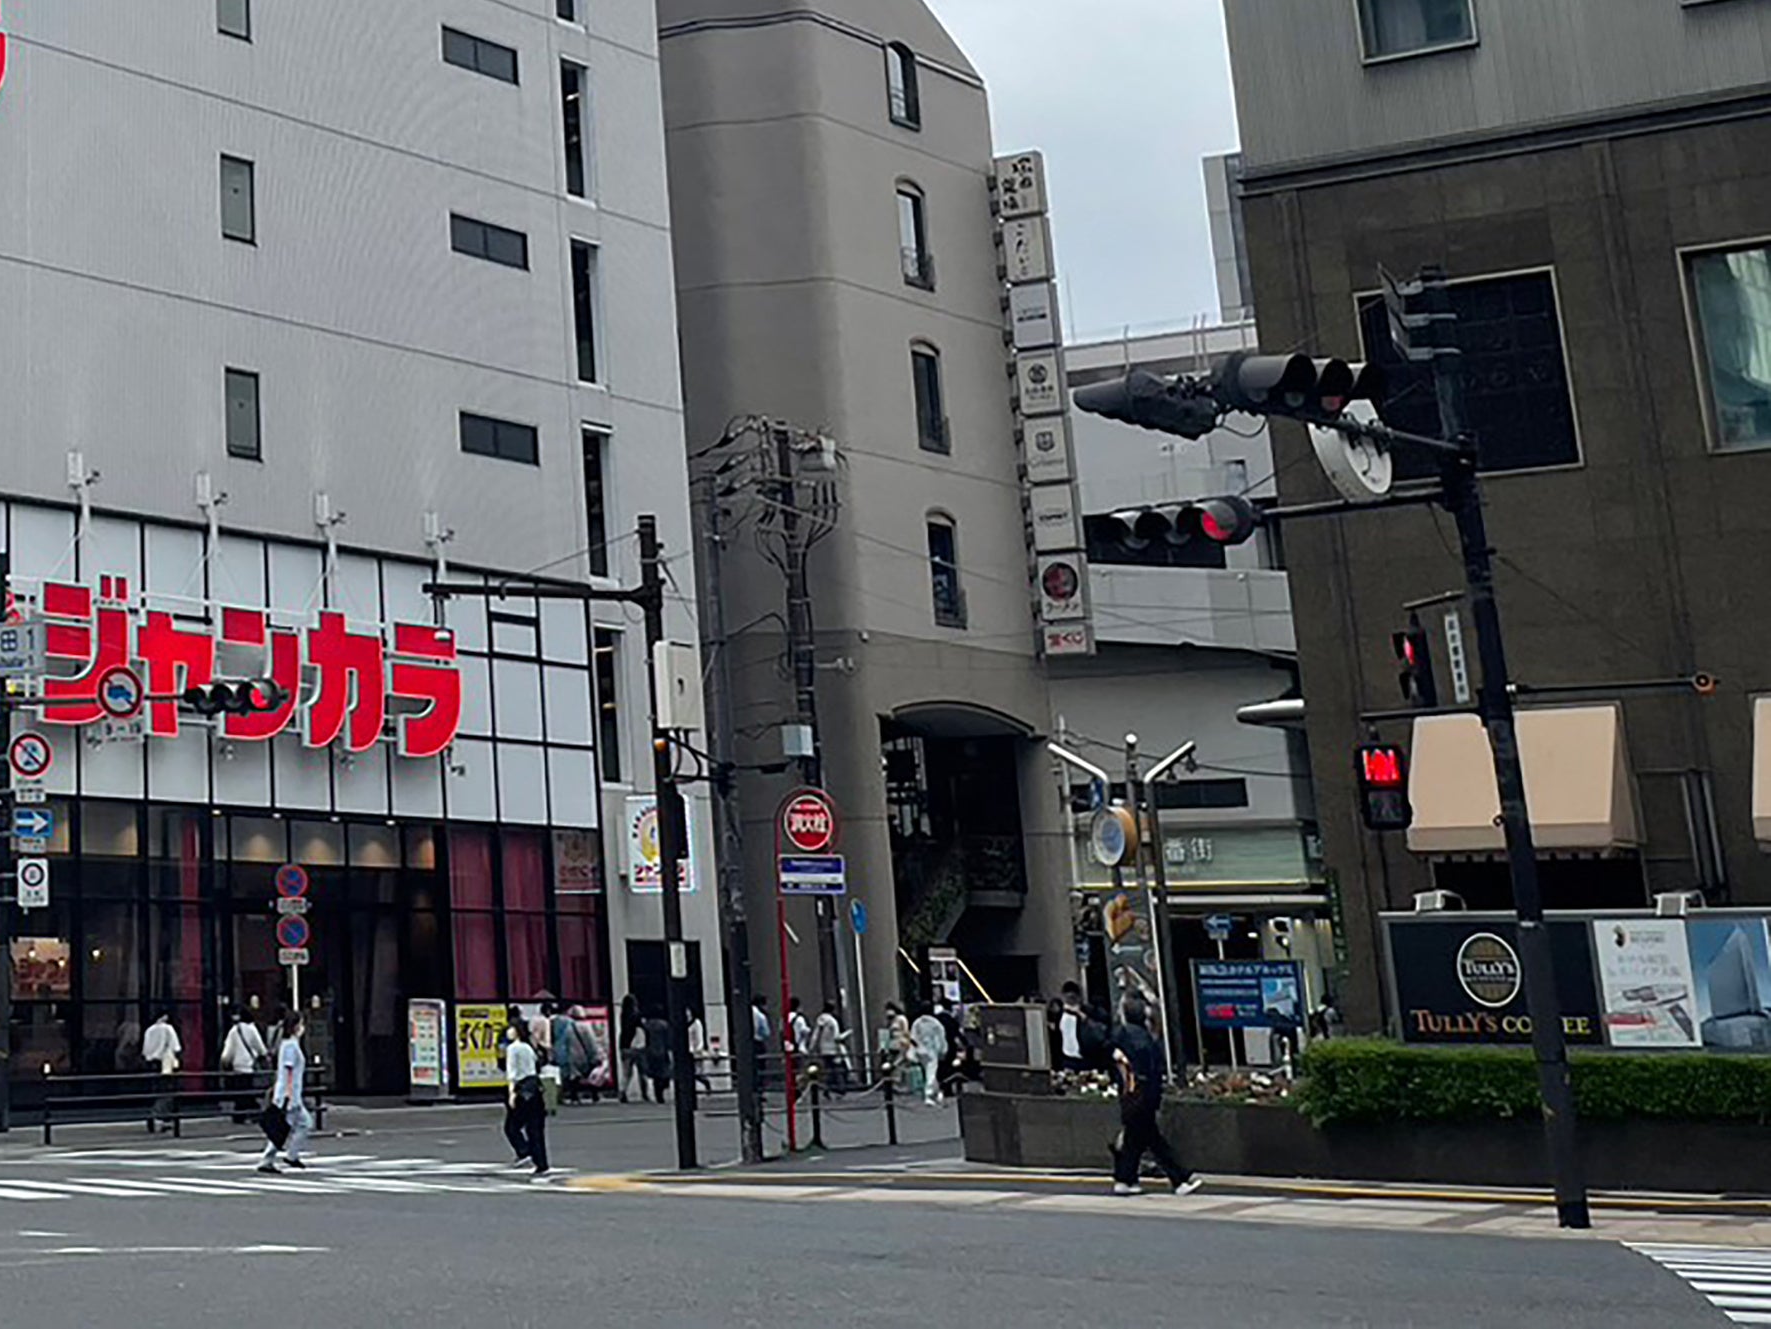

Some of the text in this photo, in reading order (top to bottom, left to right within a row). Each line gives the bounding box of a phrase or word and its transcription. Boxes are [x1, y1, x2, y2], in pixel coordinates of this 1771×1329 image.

[43, 575, 461, 758] ジャンカラ
[1410, 1009, 1591, 1036] TULLY'S COEE
